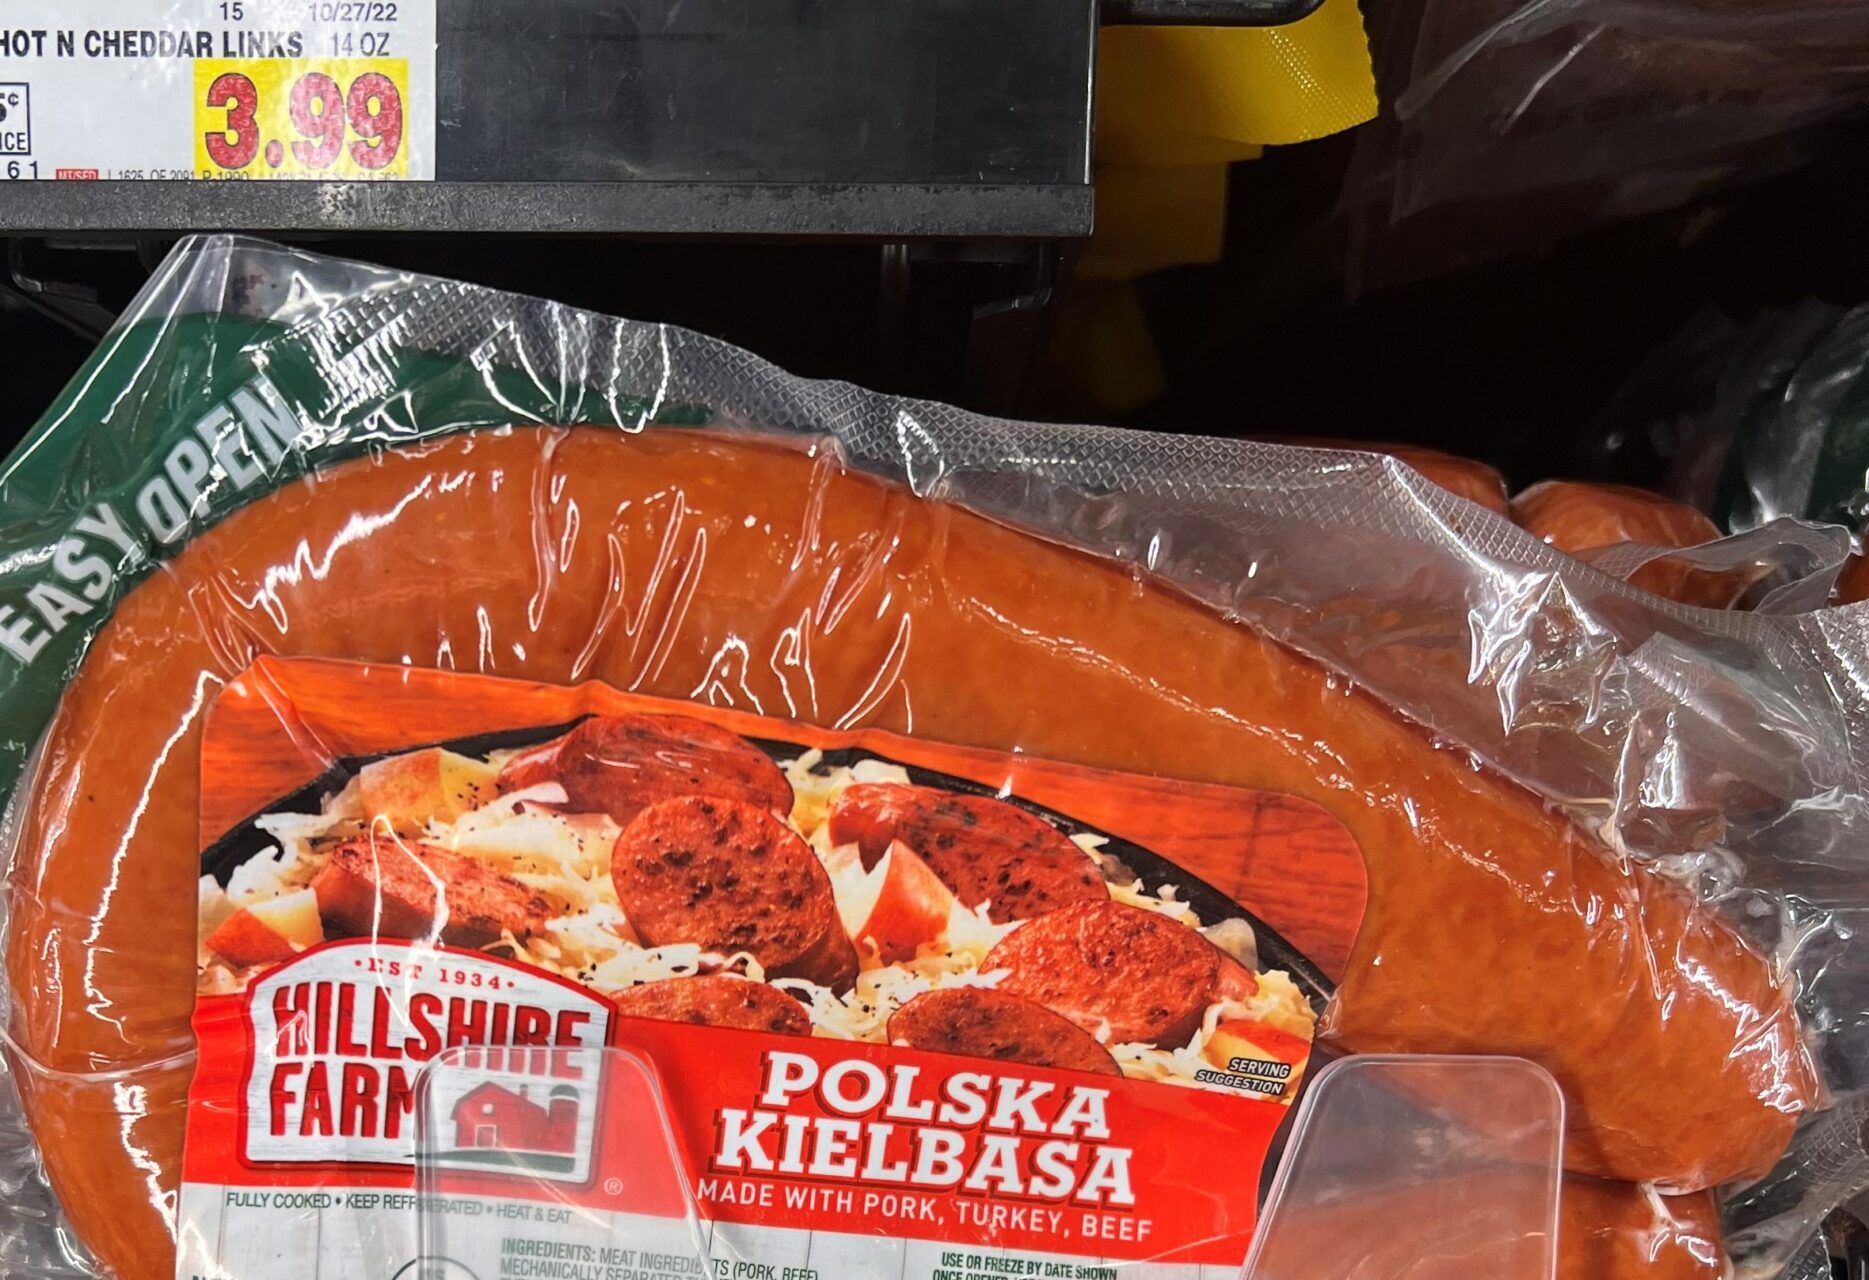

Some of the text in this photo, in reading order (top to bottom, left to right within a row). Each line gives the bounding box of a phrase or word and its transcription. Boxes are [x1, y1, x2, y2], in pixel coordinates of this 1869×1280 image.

[220, 1, 243, 21] 15
[309, 2, 398, 22] 10/27/22
[57, 30, 74, 57] N
[84, 29, 213, 58] CHEDDAR
[222, 30, 304, 58] LINKS
[331, 32, 390, 57] 14 OZ
[204, 72, 403, 170] 3.99
[0, 376, 303, 666] EASY OPEN
[367, 957, 501, 989] EST 1934
[272, 981, 591, 1079] HILLSHIRE
[1195, 1070, 1284, 1095] SUGGESTION
[1229, 1058, 1291, 1078] SERVING
[759, 1049, 1111, 1139] POLSKA
[712, 1107, 1136, 1207] KIELBASA
[225, 1192, 272, 1209] FULLY
[273, 1193, 331, 1210] COOKED
[345, 1194, 380, 1210] KEEP
[497, 1201, 533, 1221] HEAT
[534, 1204, 545, 1222] &
[547, 1206, 573, 1224] EAT
[697, 1178, 1153, 1243] MADE WITH PORK, TURKEY, BEEF
[502, 1238, 597, 1263] INGREDIENTS:
[599, 1247, 637, 1267] MEAT
[941, 1251, 1118, 1280] USE OR FREEZE BY DATE SHOWN
